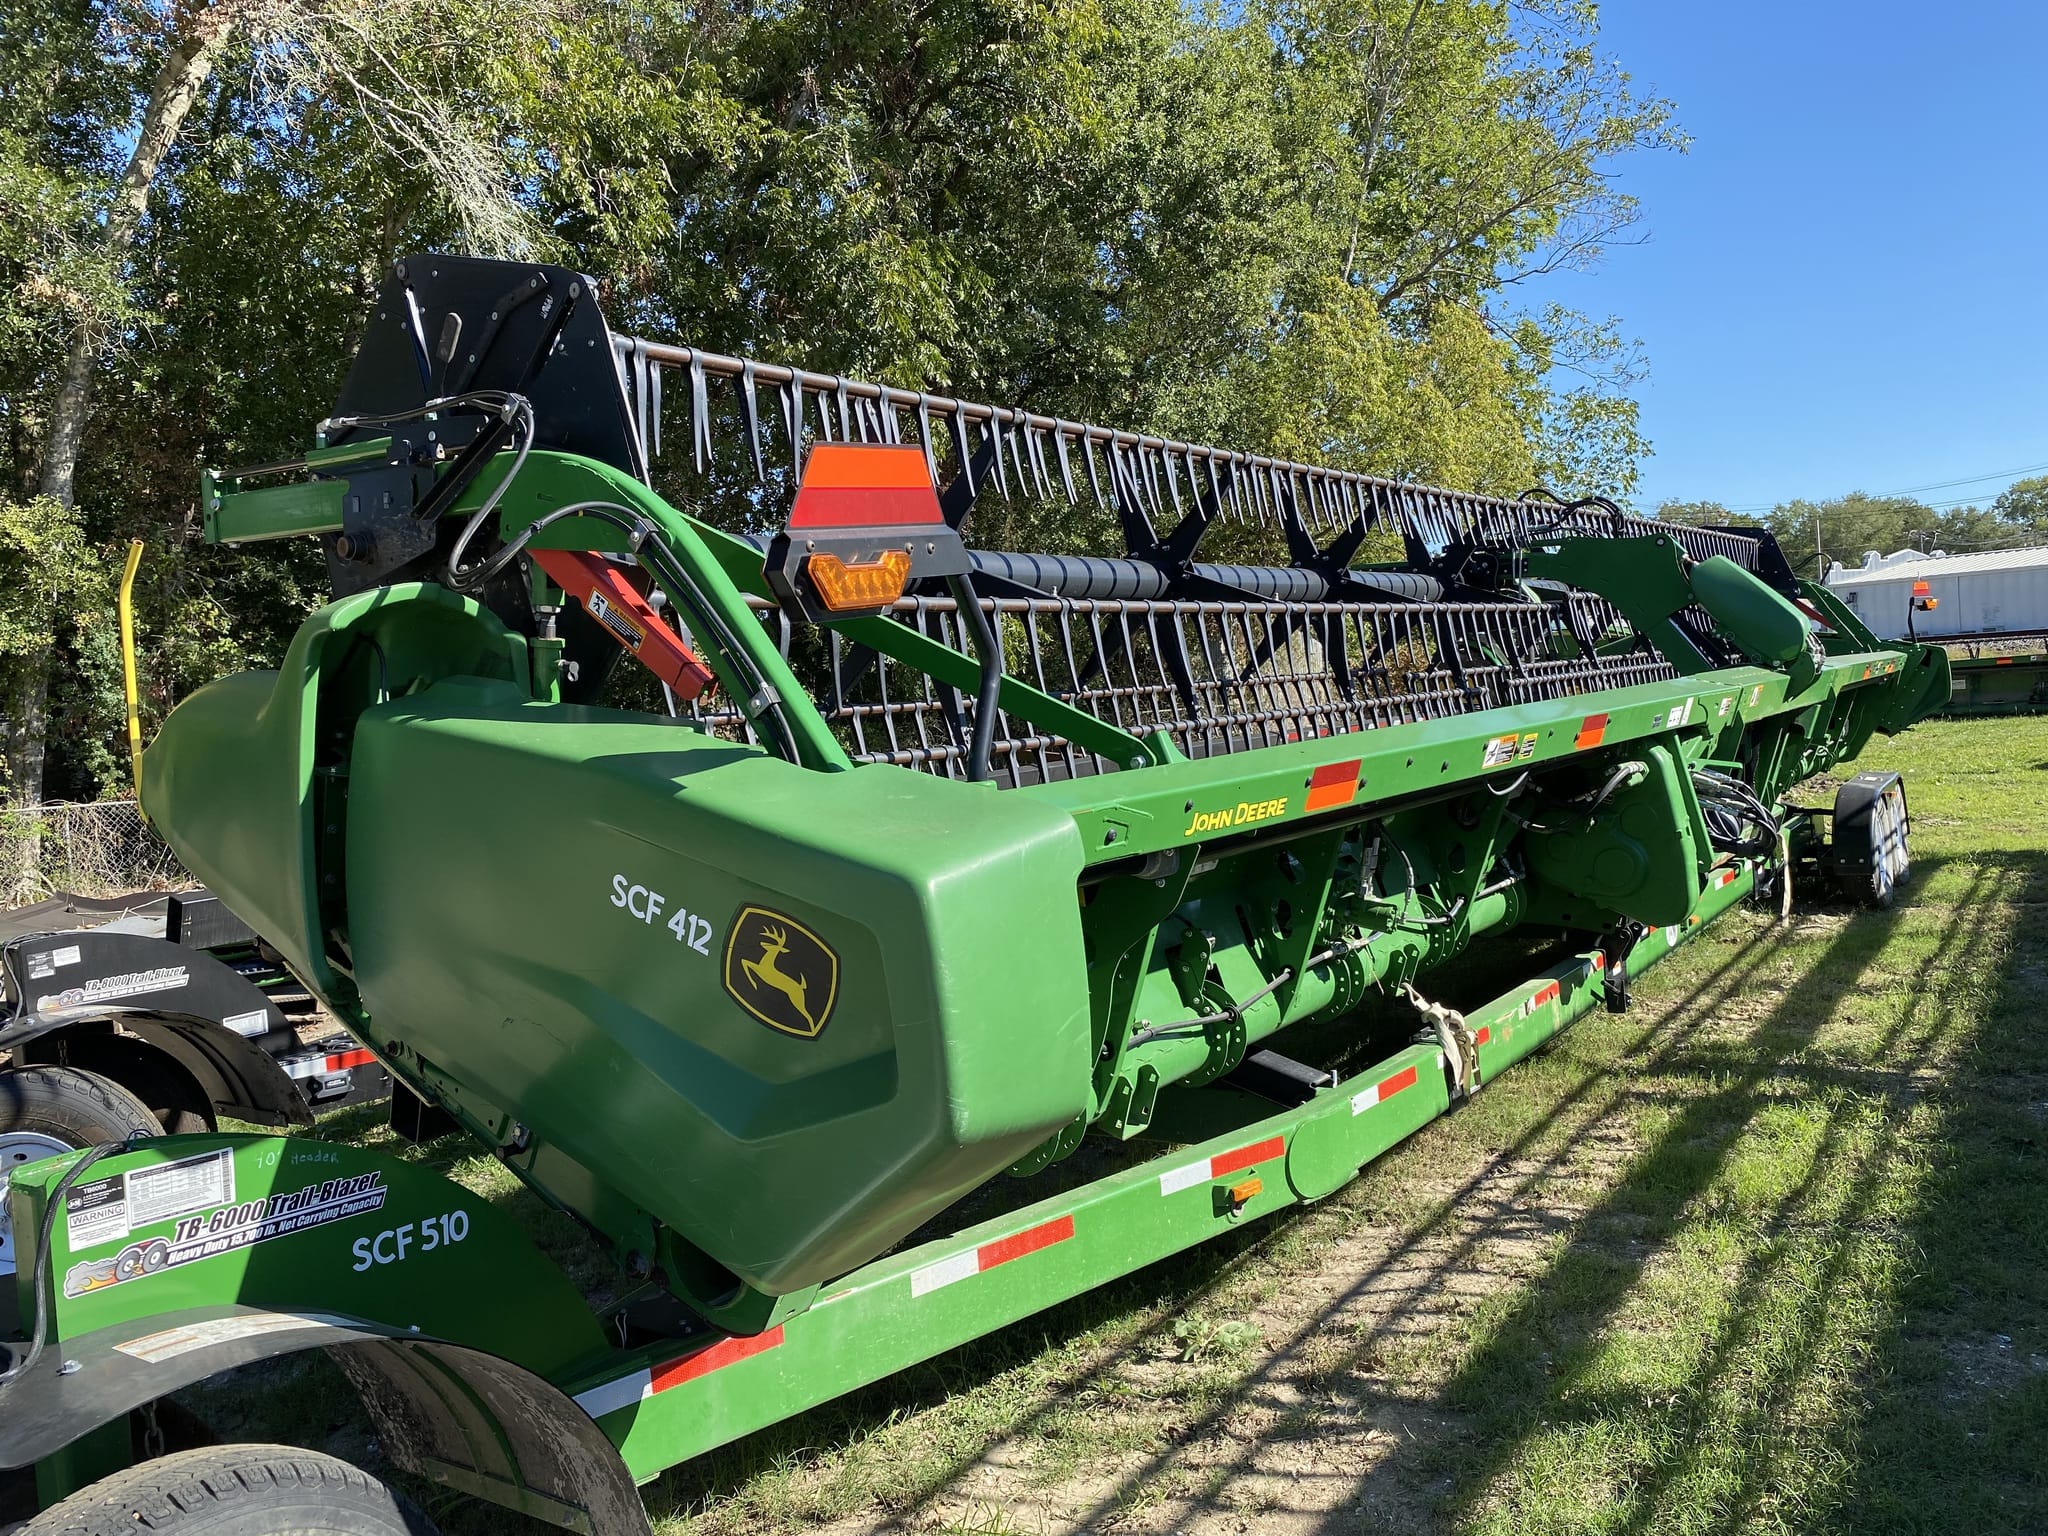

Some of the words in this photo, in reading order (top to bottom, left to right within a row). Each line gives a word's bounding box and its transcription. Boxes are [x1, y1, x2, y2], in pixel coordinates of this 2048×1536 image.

[1184, 808, 1234, 837] JOHN
[1234, 797, 1289, 825] DEERE
[610, 874, 665, 925] SCF
[667, 908, 713, 957] 412
[86, 974, 129, 992] TB-8000
[72, 1205, 123, 1225] WARNING
[167, 1244, 204, 1265] Heavy
[203, 1239, 229, 1255] Duty
[230, 1227, 263, 1246] 15,700
[264, 1223, 277, 1237] lb.
[278, 1218, 296, 1233] Net
[296, 1207, 340, 1228] Carrying
[340, 1194, 382, 1215] Capacity
[175, 1199, 266, 1242] TB-6000
[267, 1171, 381, 1218] Trail-Blazer
[352, 1223, 414, 1272] SCF
[421, 1209, 469, 1251] 510
